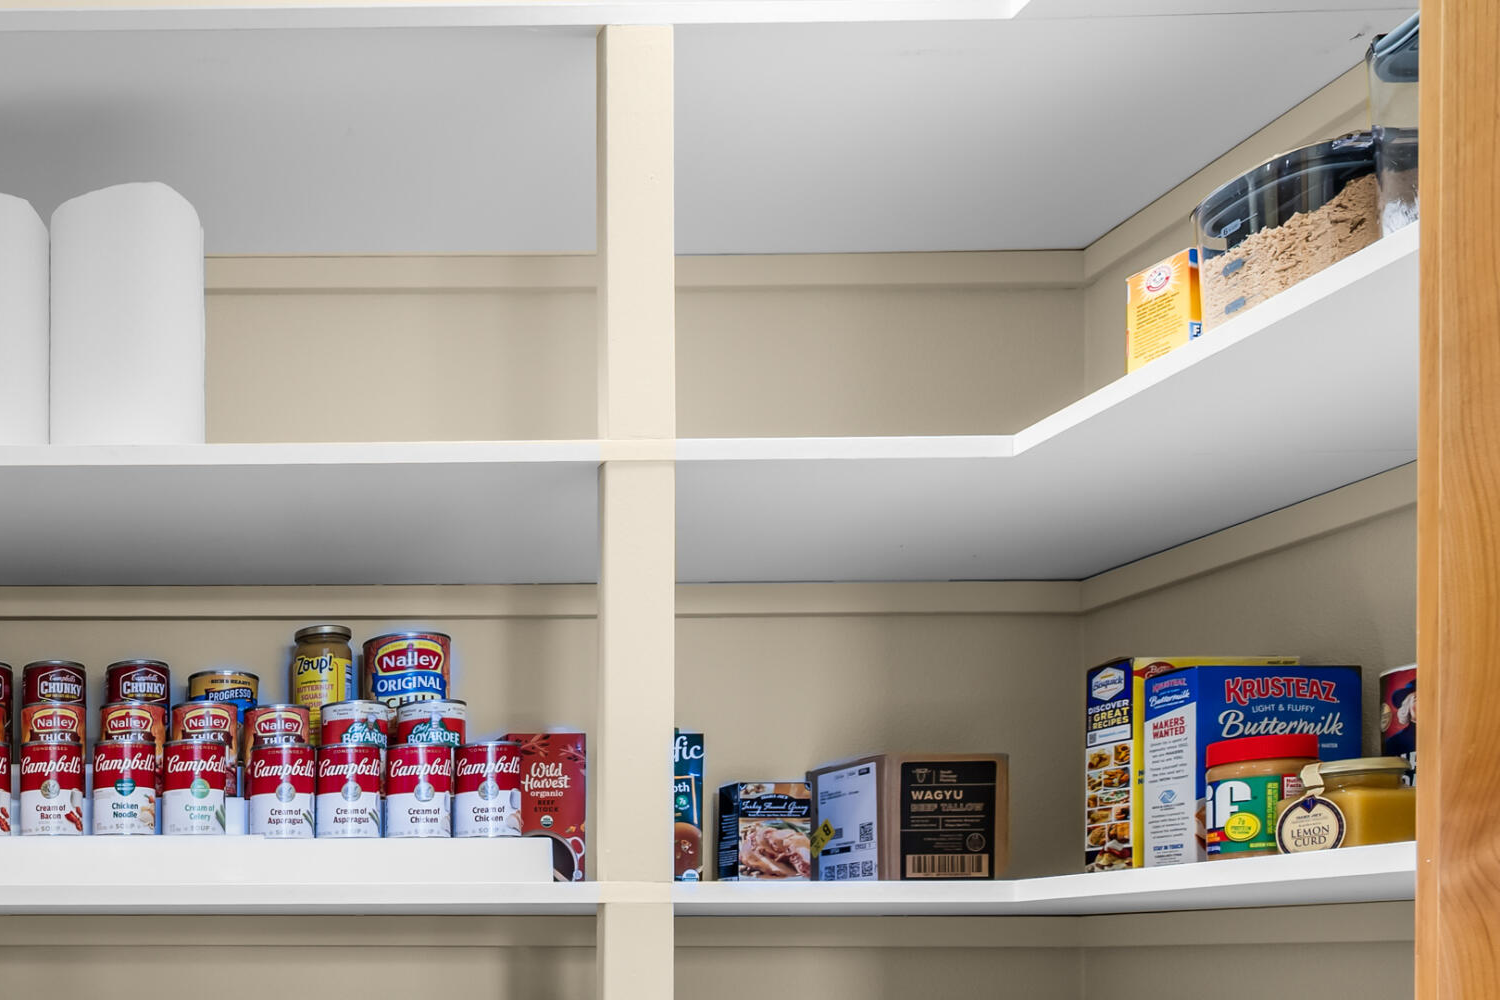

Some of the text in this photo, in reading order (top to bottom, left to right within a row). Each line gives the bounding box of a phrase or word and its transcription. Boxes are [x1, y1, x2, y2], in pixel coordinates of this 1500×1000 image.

[297, 654, 334, 676] Zoup!
[382, 652, 439, 669] Nalley
[40, 681, 83, 697] CHUNKY
[122, 681, 165, 697] CHUNKY
[377, 674, 442, 692] ORIGINAL
[208, 688, 251, 702] PROGRESSO
[1224, 677, 1338, 706] KRUSTEAZ
[1088, 699, 1130, 715] DISCOVER
[1093, 707, 1130, 722] GREAT
[1251, 704, 1315, 714] LIGHT FLUFFY
[37, 717, 74, 729] Nalley
[110, 717, 148, 729] Nalley
[187, 717, 228, 730] Nalley
[260, 720, 299, 732] Nalley
[1092, 715, 1130, 730] RECIPES
[1152, 716, 1186, 731] MAKERS
[1218, 709, 1344, 738] Buttermilk
[39, 732, 72, 742] THICK
[191, 732, 225, 742] THICK
[262, 735, 297, 744] THICK
[407, 731, 460, 746] BOYARDEE
[1152, 725, 1186, 740] WANTED
[21, 754, 81, 776] Campbell's
[95, 752, 155, 773] Campbell's
[167, 754, 226, 776] Campbell's
[253, 758, 314, 780] Campbell's
[319, 758, 380, 780] Campbell's
[390, 758, 451, 780] Campbell's
[457, 756, 520, 778] Campbell's
[531, 762, 563, 778] Wild
[521, 775, 571, 791] Harvest
[530, 790, 564, 799] organic
[911, 789, 964, 801] WAGYU
[111, 802, 139, 811] Chicken
[269, 808, 291, 817] Cream
[407, 807, 429, 816] Cream
[112, 811, 138, 819] Noodle
[409, 815, 439, 824] Chicken
[1290, 825, 1330, 840] LEMON
[1294, 834, 1328, 848] CURD
